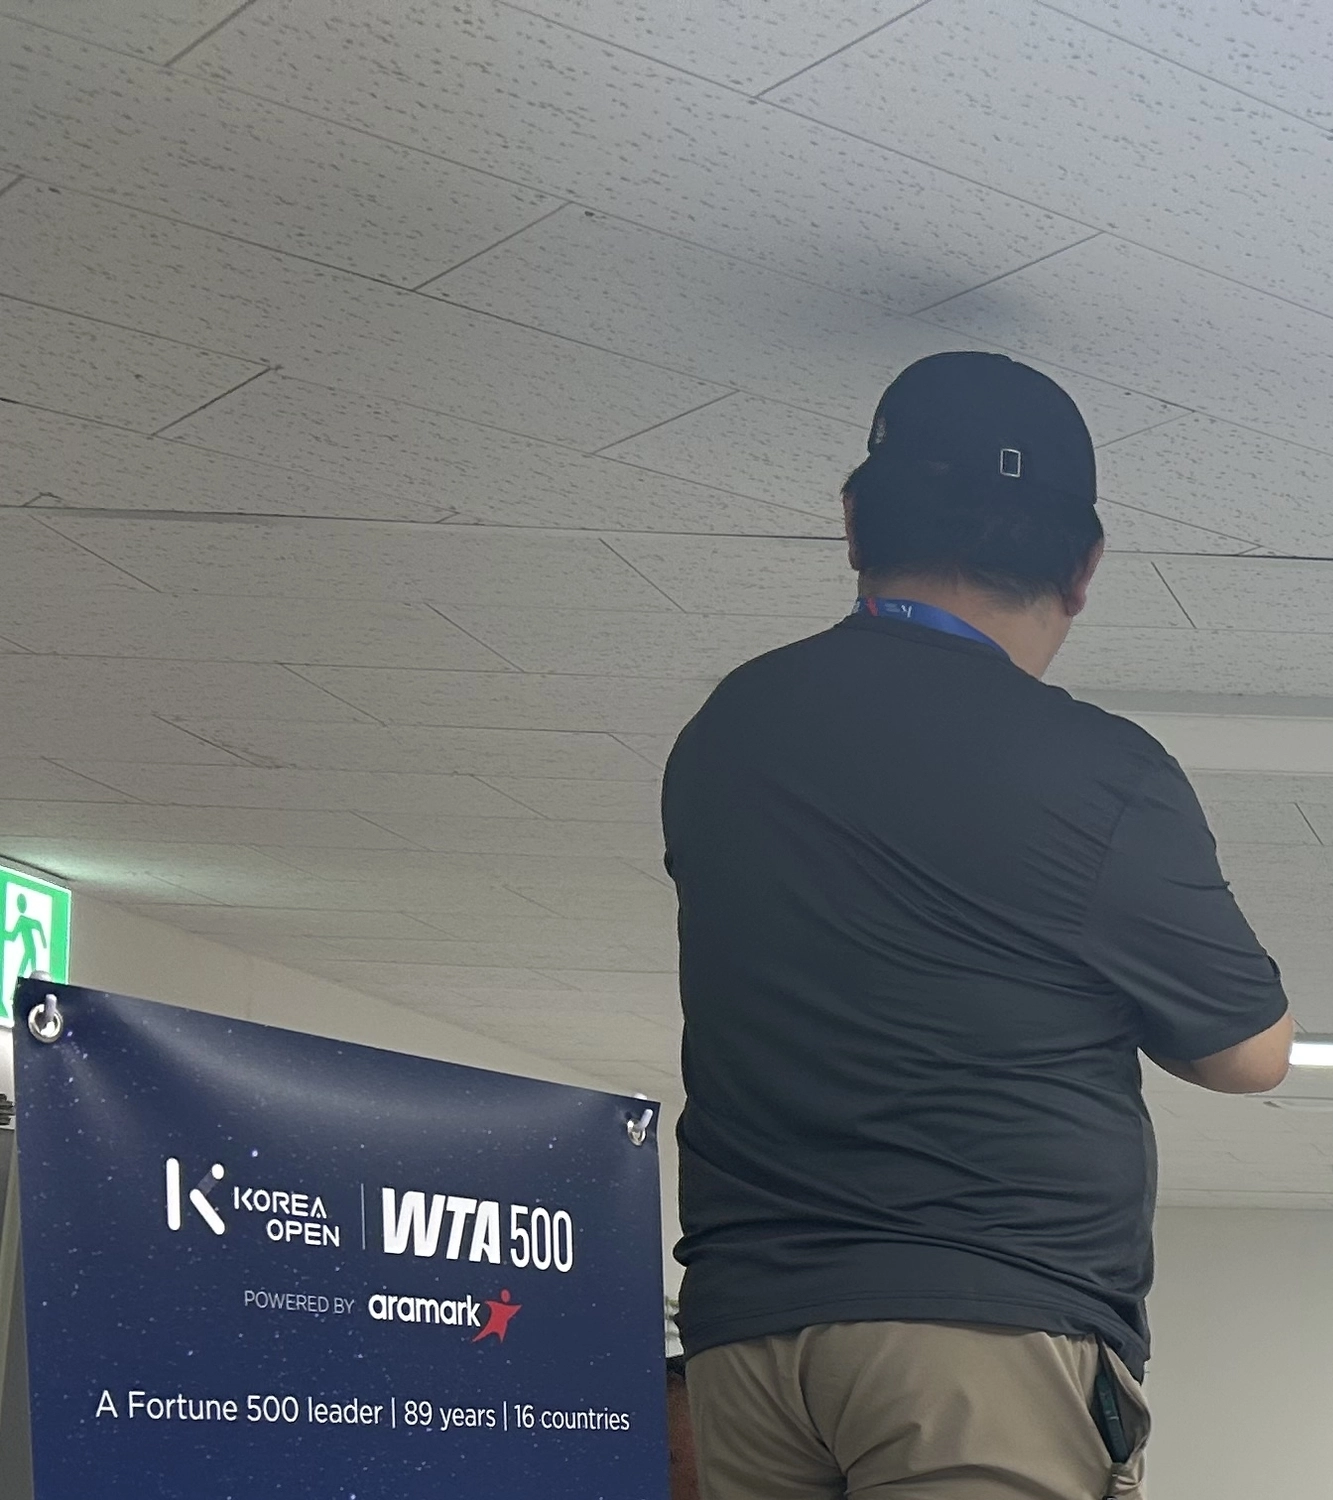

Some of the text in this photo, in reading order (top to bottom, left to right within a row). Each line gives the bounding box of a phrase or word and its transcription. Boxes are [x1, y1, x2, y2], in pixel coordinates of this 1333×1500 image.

[233, 1186, 328, 1219] KOREA
[266, 1218, 341, 1248] OPEN
[381, 1187, 574, 1273] WTA 500
[244, 1290, 482, 1327] POWERED BY aramark
[95, 1389, 119, 1418] A
[129, 1390, 238, 1421] Fortune
[247, 1395, 300, 1423] 500
[308, 1396, 383, 1424] leader
[404, 1400, 433, 1426] 89
[440, 1406, 496, 1431] years
[514, 1404, 535, 1428] 16
[541, 1407, 630, 1430] countries
